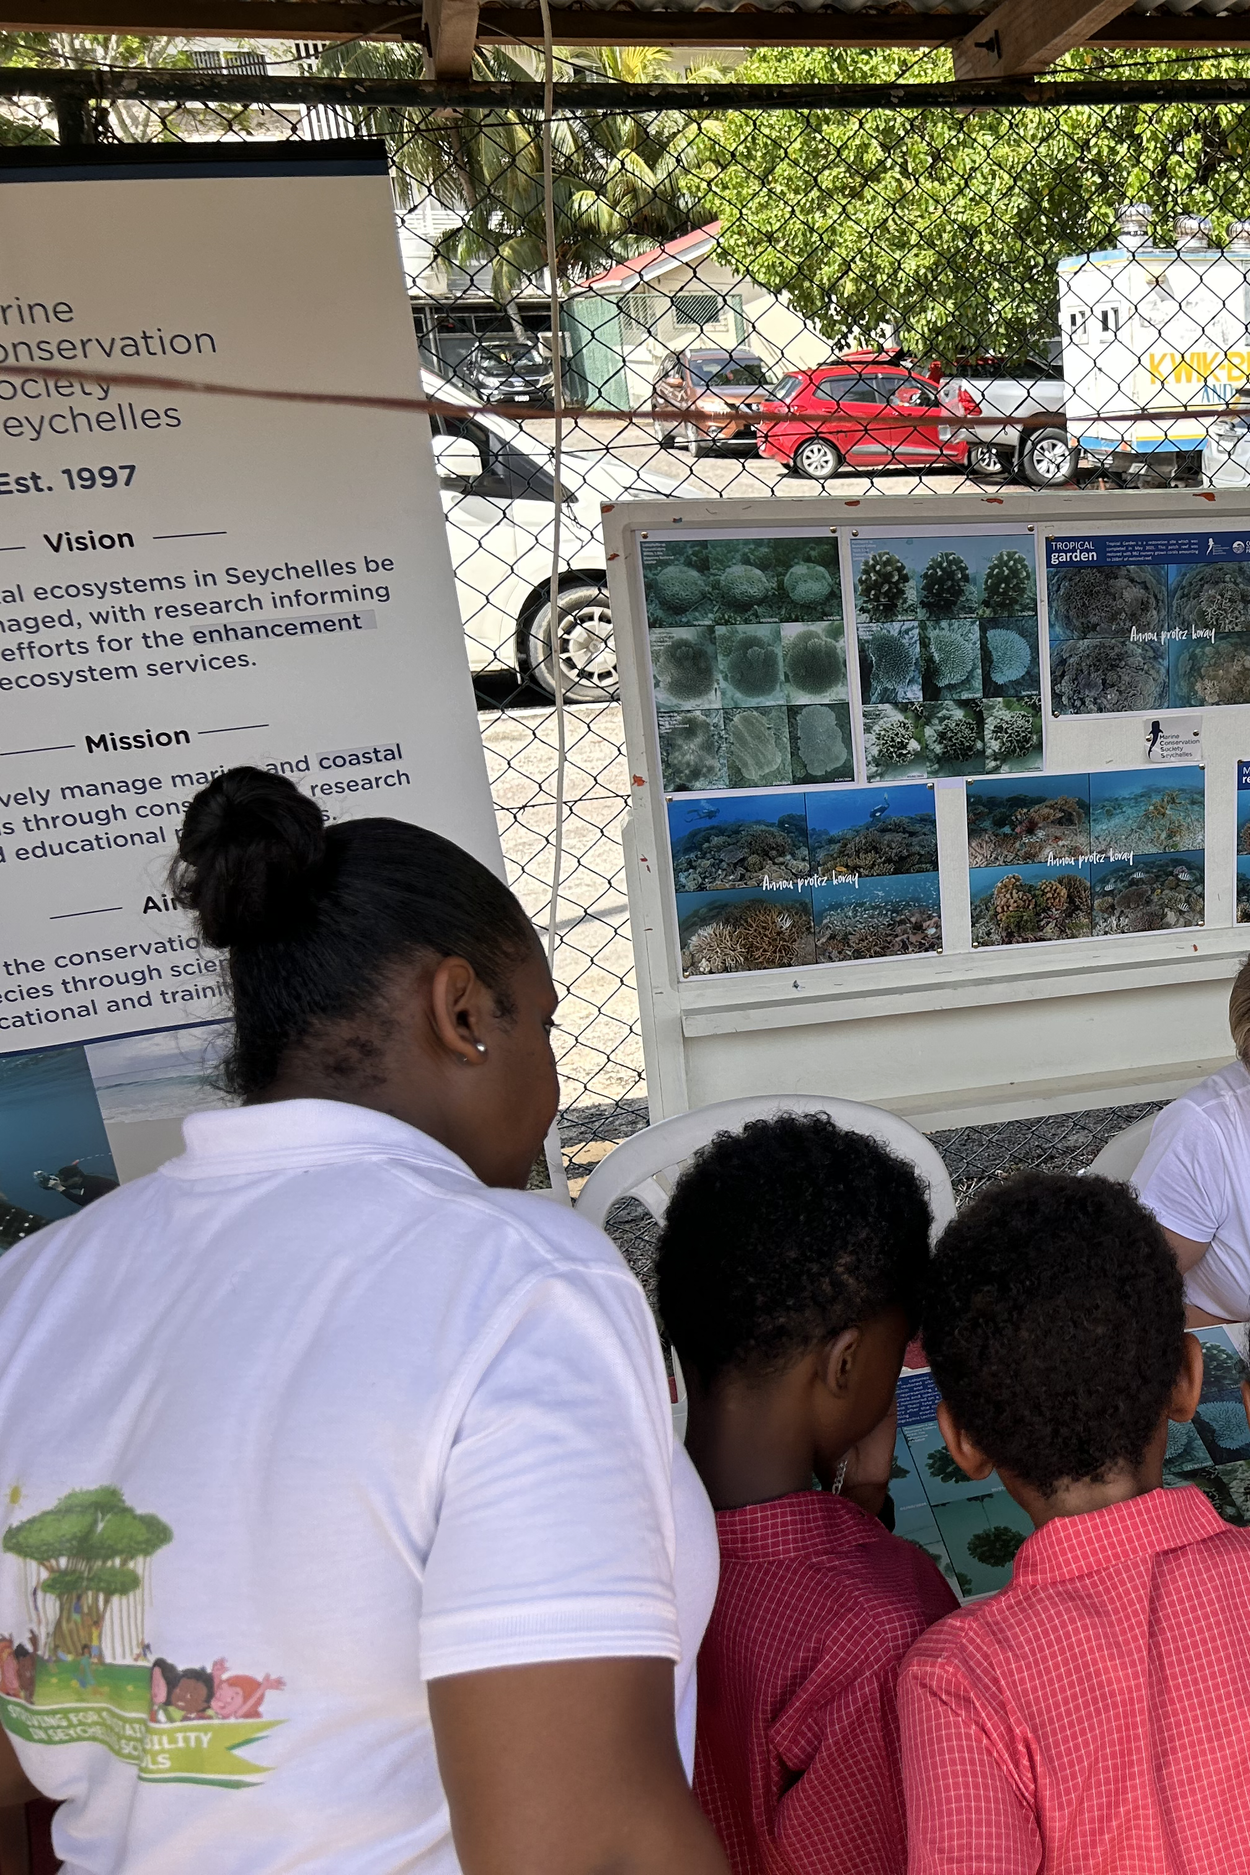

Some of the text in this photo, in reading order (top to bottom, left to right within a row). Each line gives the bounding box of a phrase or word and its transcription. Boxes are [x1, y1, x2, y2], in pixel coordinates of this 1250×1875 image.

[0, 297, 74, 325] rine
[3, 403, 182, 442] eychelles
[0, 464, 137, 495] Est. 1997
[43, 529, 135, 554] Vision
[1050, 550, 1097, 565] garden
[1051, 541, 1095, 550] TROPICAL
[33, 573, 187, 602] ecosystems
[194, 569, 218, 588] in
[225, 559, 357, 588] Seychelles
[364, 555, 395, 573] be
[89, 602, 146, 626] with
[154, 593, 263, 620] research
[270, 582, 391, 610] informing
[1, 612, 363, 662] efforts for the enhancement
[1130, 624, 1215, 645] Annou protez koray
[0, 651, 257, 691] ecosystem services.
[84, 726, 192, 755] Mission
[0, 742, 403, 807] vely manage mari and coastal
[22, 804, 127, 833] through
[310, 769, 411, 797] research
[15, 826, 167, 861] educational
[1047, 847, 1134, 869] Annou protez koray
[762, 869, 859, 893] Annou protez koray
[3, 934, 200, 977] the conservatio
[0, 984, 54, 1004] cies
[61, 964, 163, 994] through
[0, 1000, 98, 1030] cational
[107, 990, 153, 1013] and
